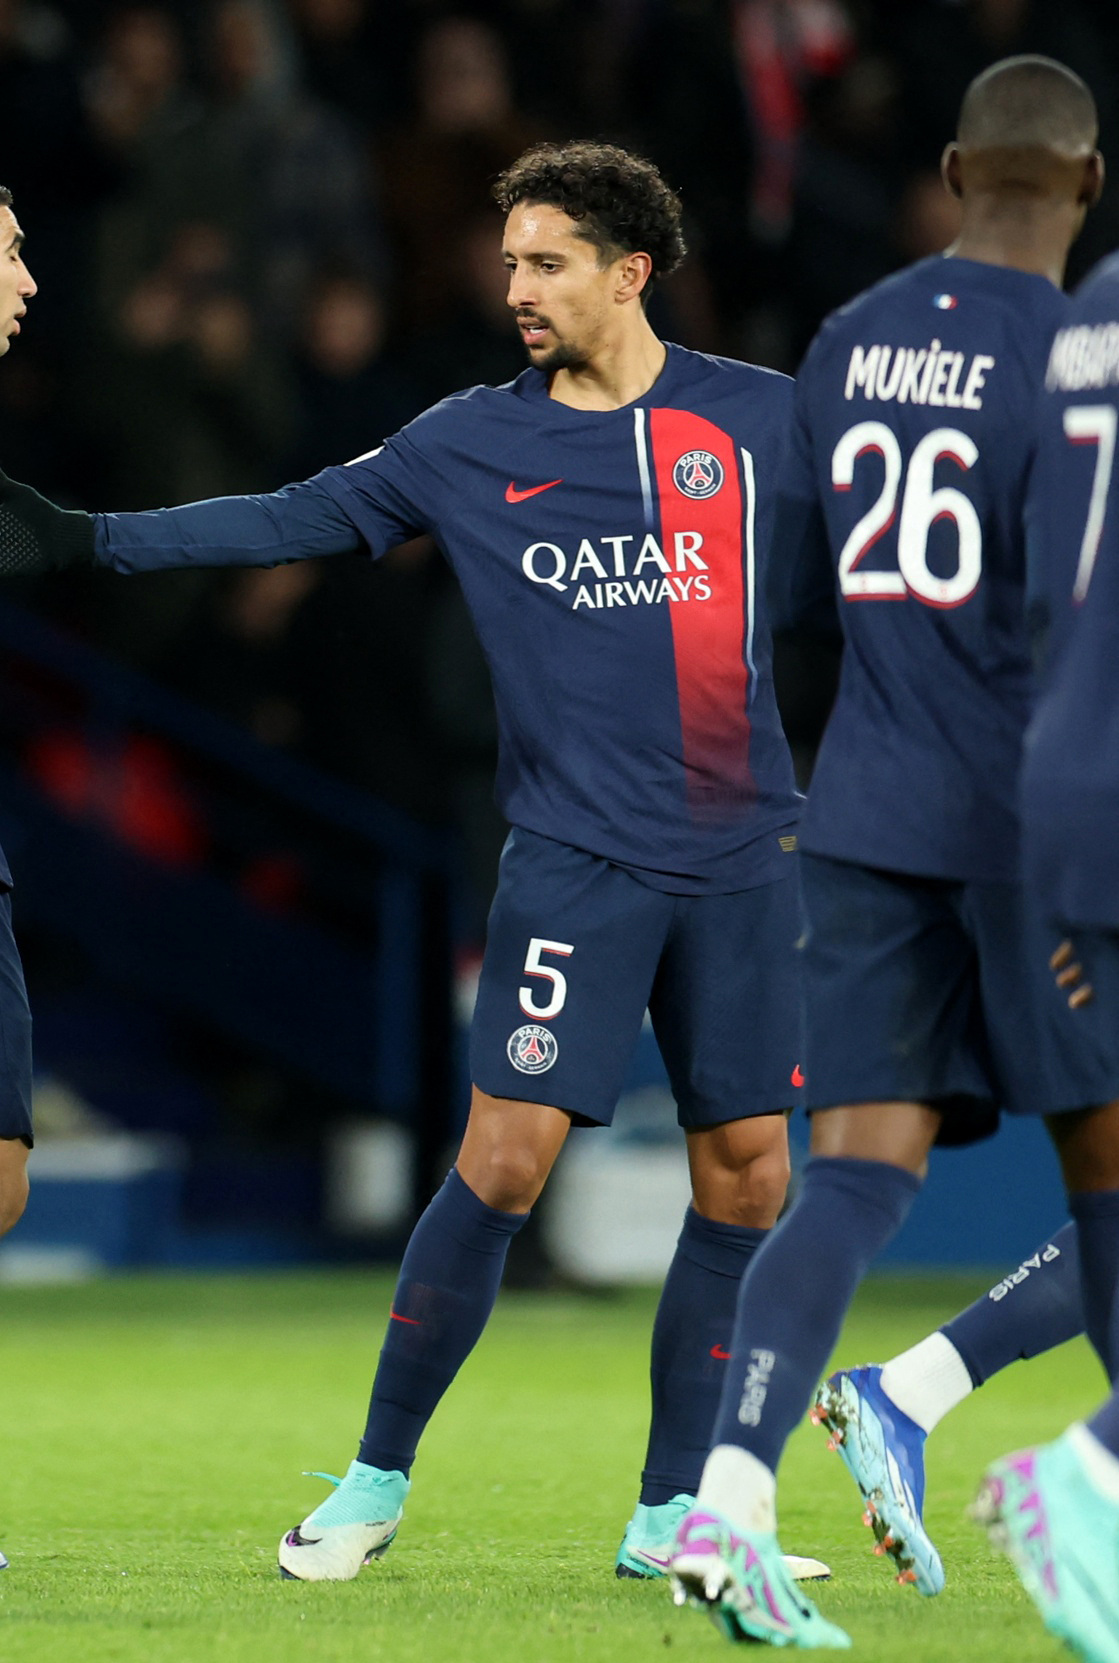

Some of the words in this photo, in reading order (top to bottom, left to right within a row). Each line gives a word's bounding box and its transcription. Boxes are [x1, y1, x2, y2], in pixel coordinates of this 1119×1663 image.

[680, 453, 713, 468] PARIS
[831, 420, 983, 610] 26
[1062, 403, 1119, 606] 7
[521, 531, 710, 592] QATAR
[572, 574, 712, 610] AIRWAYS
[518, 937, 575, 1021] 5
[517, 1027, 552, 1042] PARIS
[988, 1244, 1061, 1302] PARIS
[738, 1348, 776, 1428] PARIS
